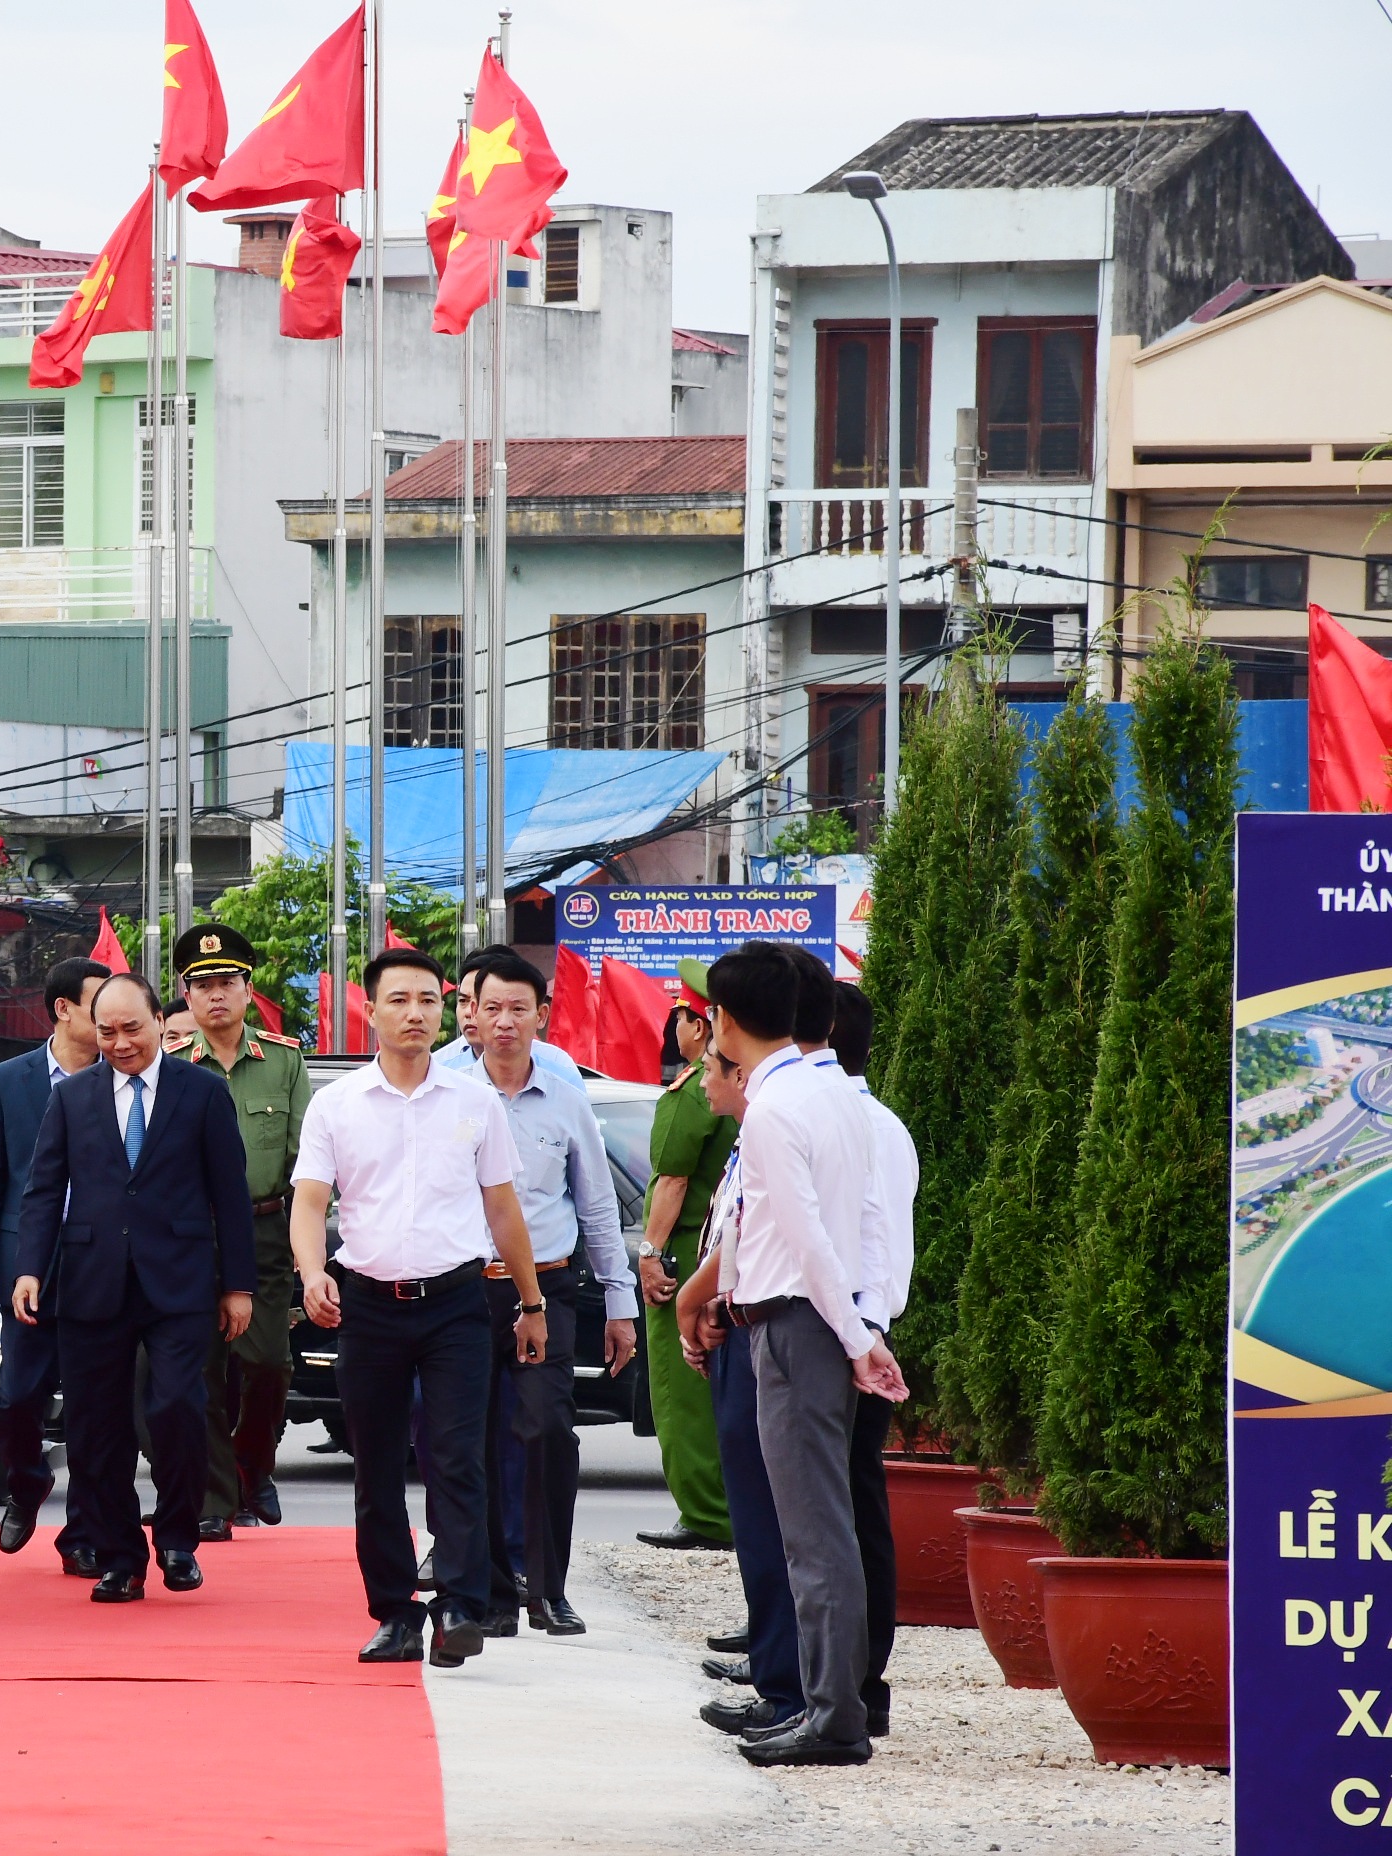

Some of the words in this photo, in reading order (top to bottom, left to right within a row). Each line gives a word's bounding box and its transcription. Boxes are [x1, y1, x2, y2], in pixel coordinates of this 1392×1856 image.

[569, 898, 593, 913] 15
[609, 889, 641, 900] CỬA
[645, 889, 689, 900] HÀNG
[694, 891, 733, 900] VLXD
[736, 888, 780, 900] TỔNG
[784, 890, 817, 901] HỢP
[615, 903, 711, 933] THÀNH
[715, 908, 811, 933] TRANG
[1279, 1488, 1336, 1559] LỄ
[1284, 1593, 1374, 1663] DỰ
[1336, 1689, 1392, 1738] X
[1330, 1774, 1392, 1828] C
